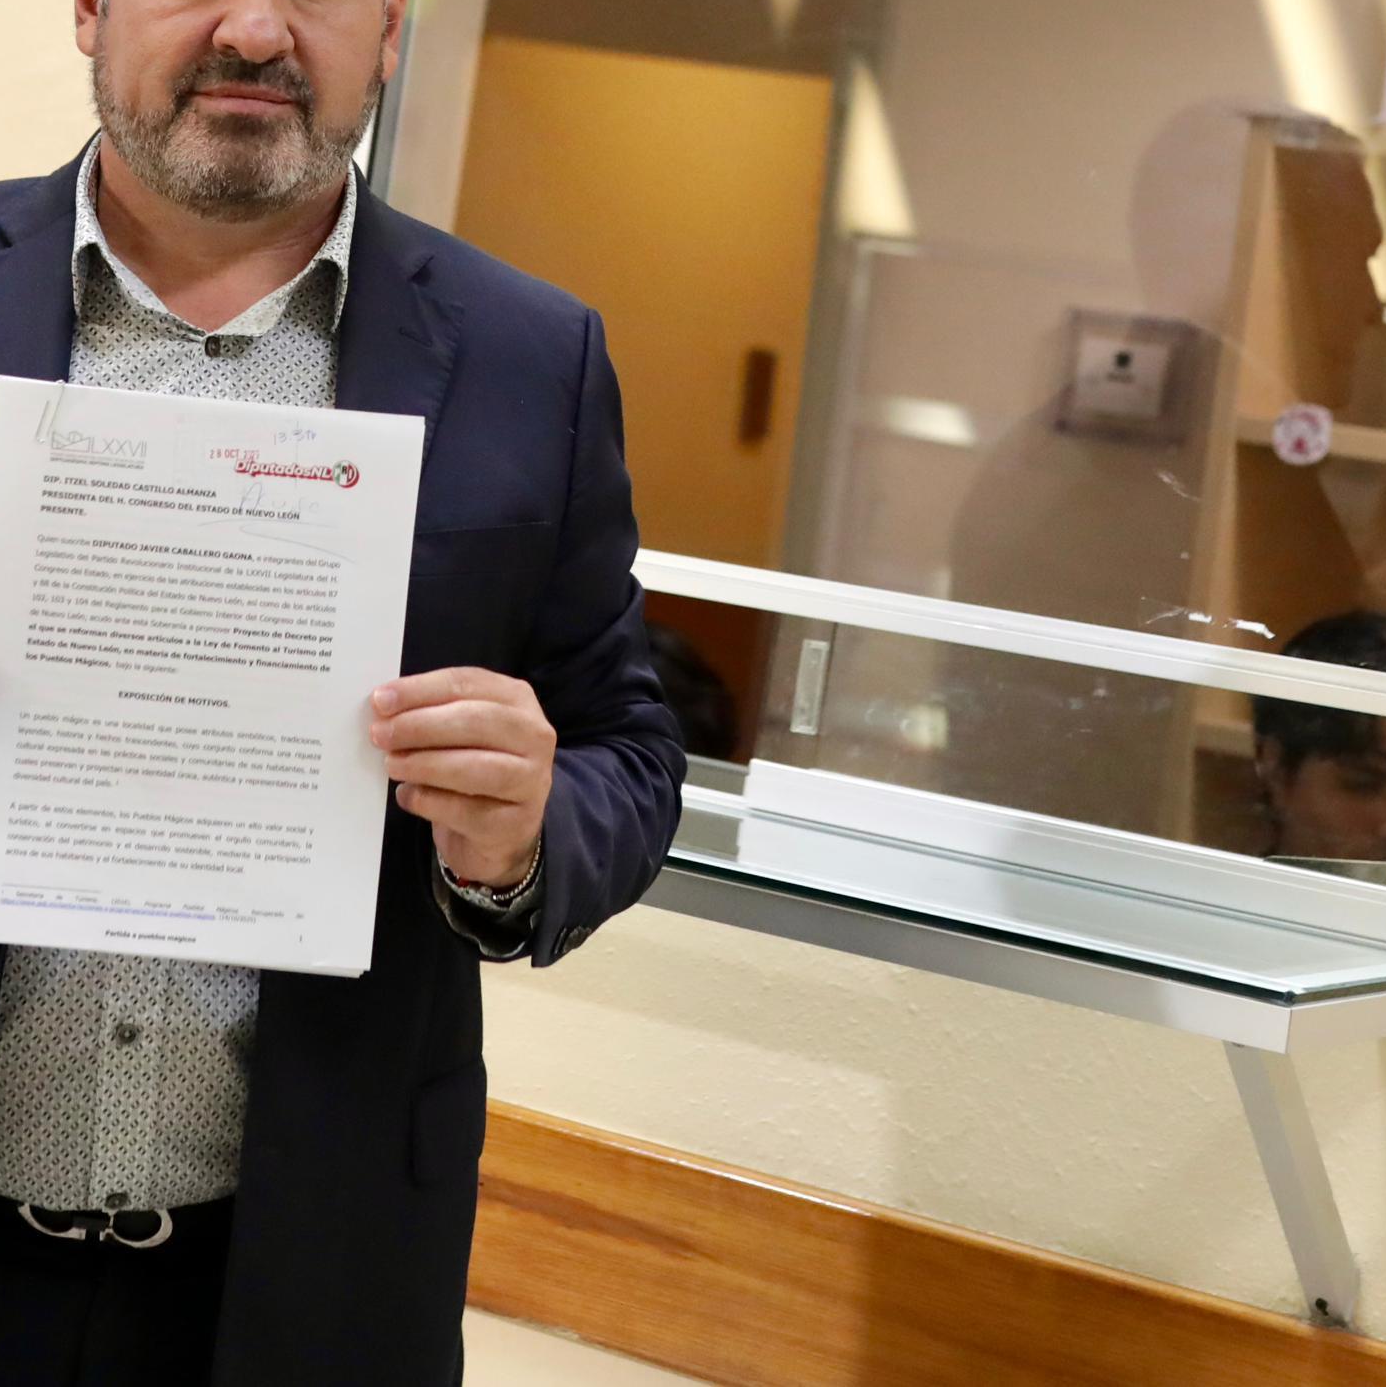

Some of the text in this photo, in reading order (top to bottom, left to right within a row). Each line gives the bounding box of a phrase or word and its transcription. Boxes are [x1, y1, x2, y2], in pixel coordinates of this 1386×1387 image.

[235, 460, 334, 481] DiputadosNL
[42, 474, 217, 498] DIP. ITZEL SOLEDAD CASTILLO ALMANZA
[39, 504, 86, 516] PRESENTE.
[41, 489, 96, 502] PRESIDENTA
[97, 494, 114, 504] DEL
[127, 497, 176, 509] CONGRESO
[176, 501, 193, 511] DEL
[195, 503, 230, 514] ESTADO
[244, 508, 275, 518] NUEVO
[276, 510, 300, 520] LEÓN
[91, 539, 138, 551] DIPUTADO
[138, 543, 170, 554] JAVIER
[170, 546, 221, 559] CABALLERO
[221, 551, 255, 561] GAONA,
[117, 690, 172, 703] EXPOSICIÓN
[187, 696, 230, 708] MOTIVOS.
